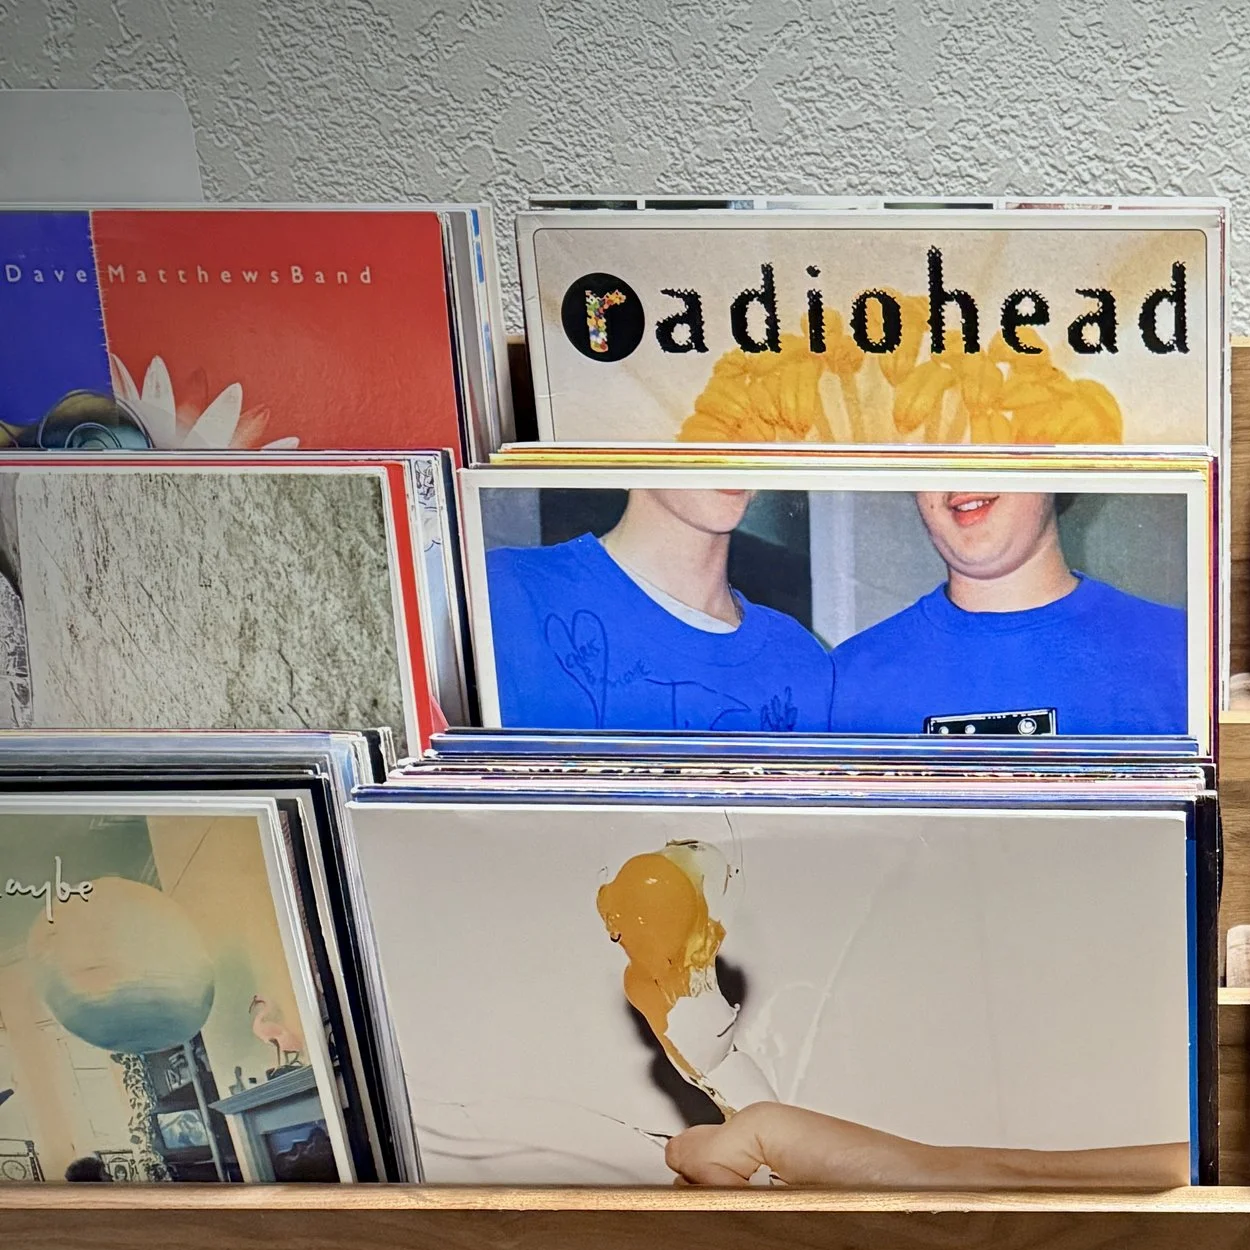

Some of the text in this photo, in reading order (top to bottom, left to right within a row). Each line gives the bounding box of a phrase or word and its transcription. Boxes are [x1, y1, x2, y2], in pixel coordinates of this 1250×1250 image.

[5, 264, 89, 284] Dave
[570, 244, 1192, 356] radiohead
[0, 855, 93, 924] aybe
